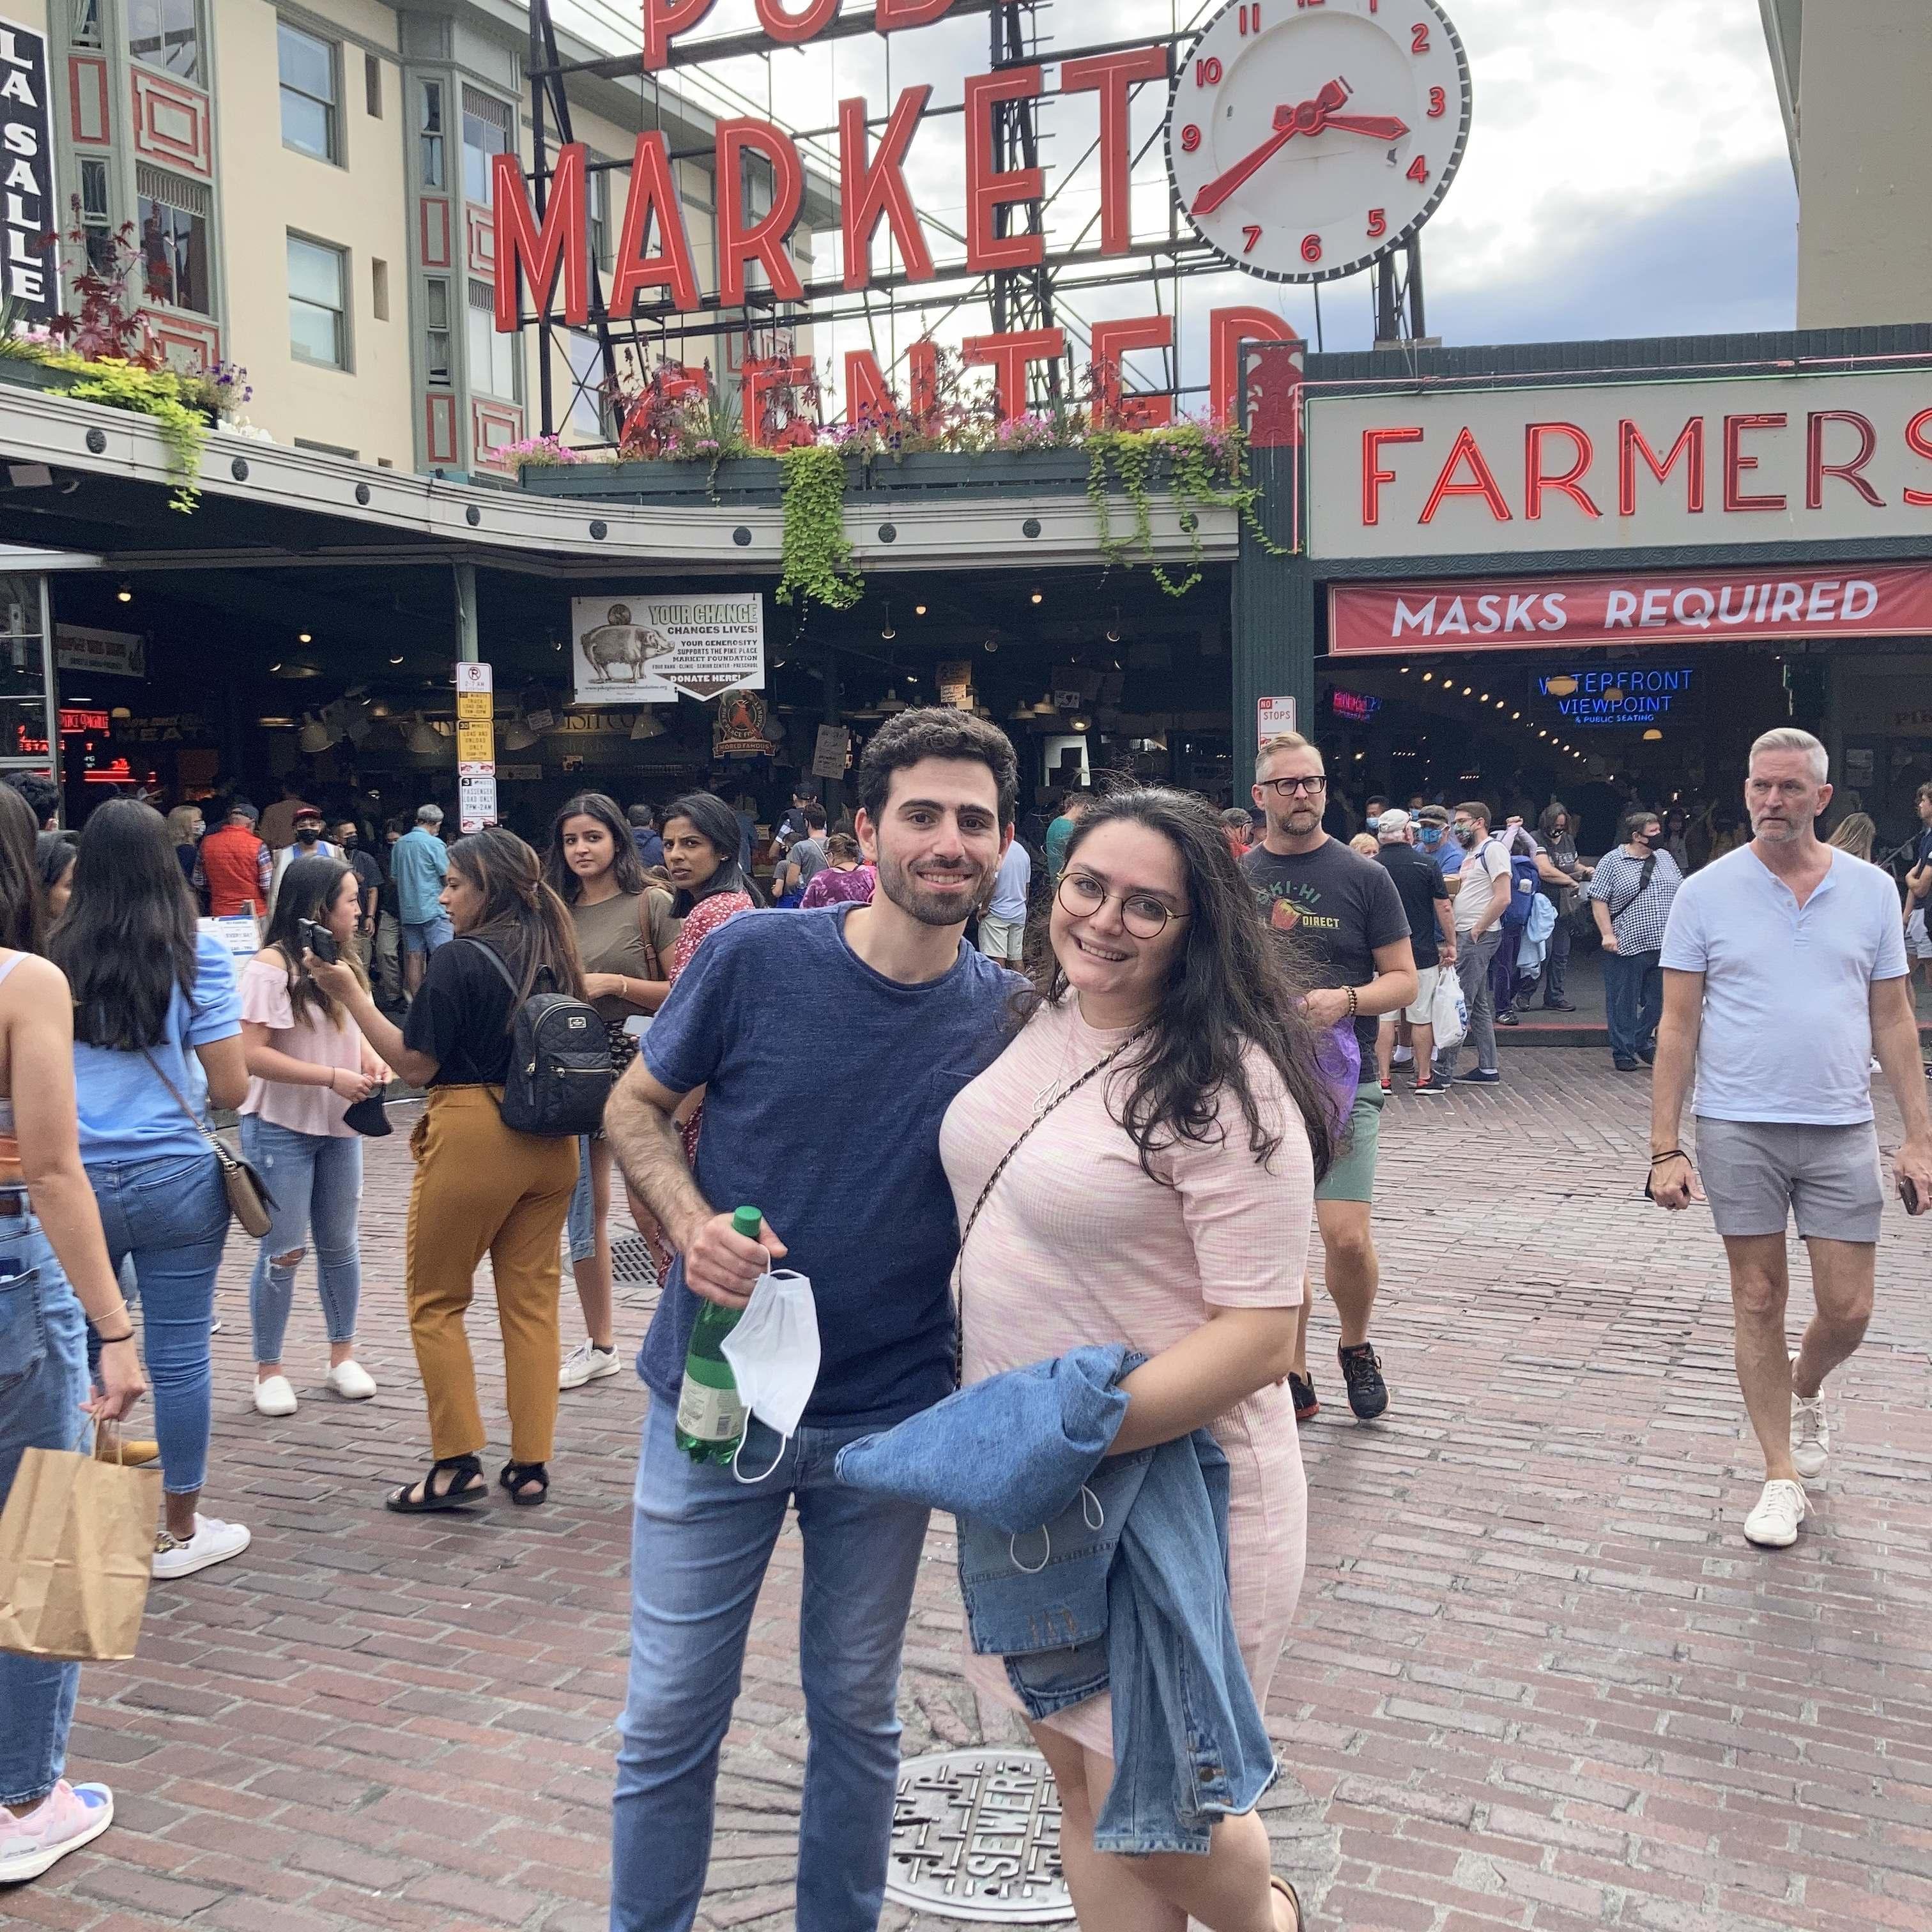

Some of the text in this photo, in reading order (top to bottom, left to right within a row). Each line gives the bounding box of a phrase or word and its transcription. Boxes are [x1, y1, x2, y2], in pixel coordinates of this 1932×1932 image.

[1239, 3, 1261, 36] 11
[1411, 23, 1430, 54] 2
[1196, 56, 1222, 88] 10
[1427, 86, 1446, 118] 3
[1181, 124, 1202, 152] 9
[1406, 155, 1429, 184] 4
[492, 47, 1167, 332] MARKET
[4, 122, 45, 303] SALLE
[1367, 208, 1386, 237] 5
[1242, 225, 1262, 253] 7
[1301, 234, 1322, 265] 6
[1361, 408, 1932, 526] FARMERS
[648, 604, 758, 625] YOUR CHANGE
[1392, 579, 1879, 638] MASKS REQUIRED
[668, 625, 758, 634] CHANGES LIVES!
[671, 674, 742, 683] DONATE HERE!
[1539, 670, 1692, 695] WTERFRONT
[1263, 710, 1291, 720] STOPS
[1559, 696, 1672, 715] VIEWPOINT
[1616, 714, 1654, 722] SEATING
[1302, 916, 1340, 928] DIRECT
[966, 1778, 1038, 1878] SEWER
